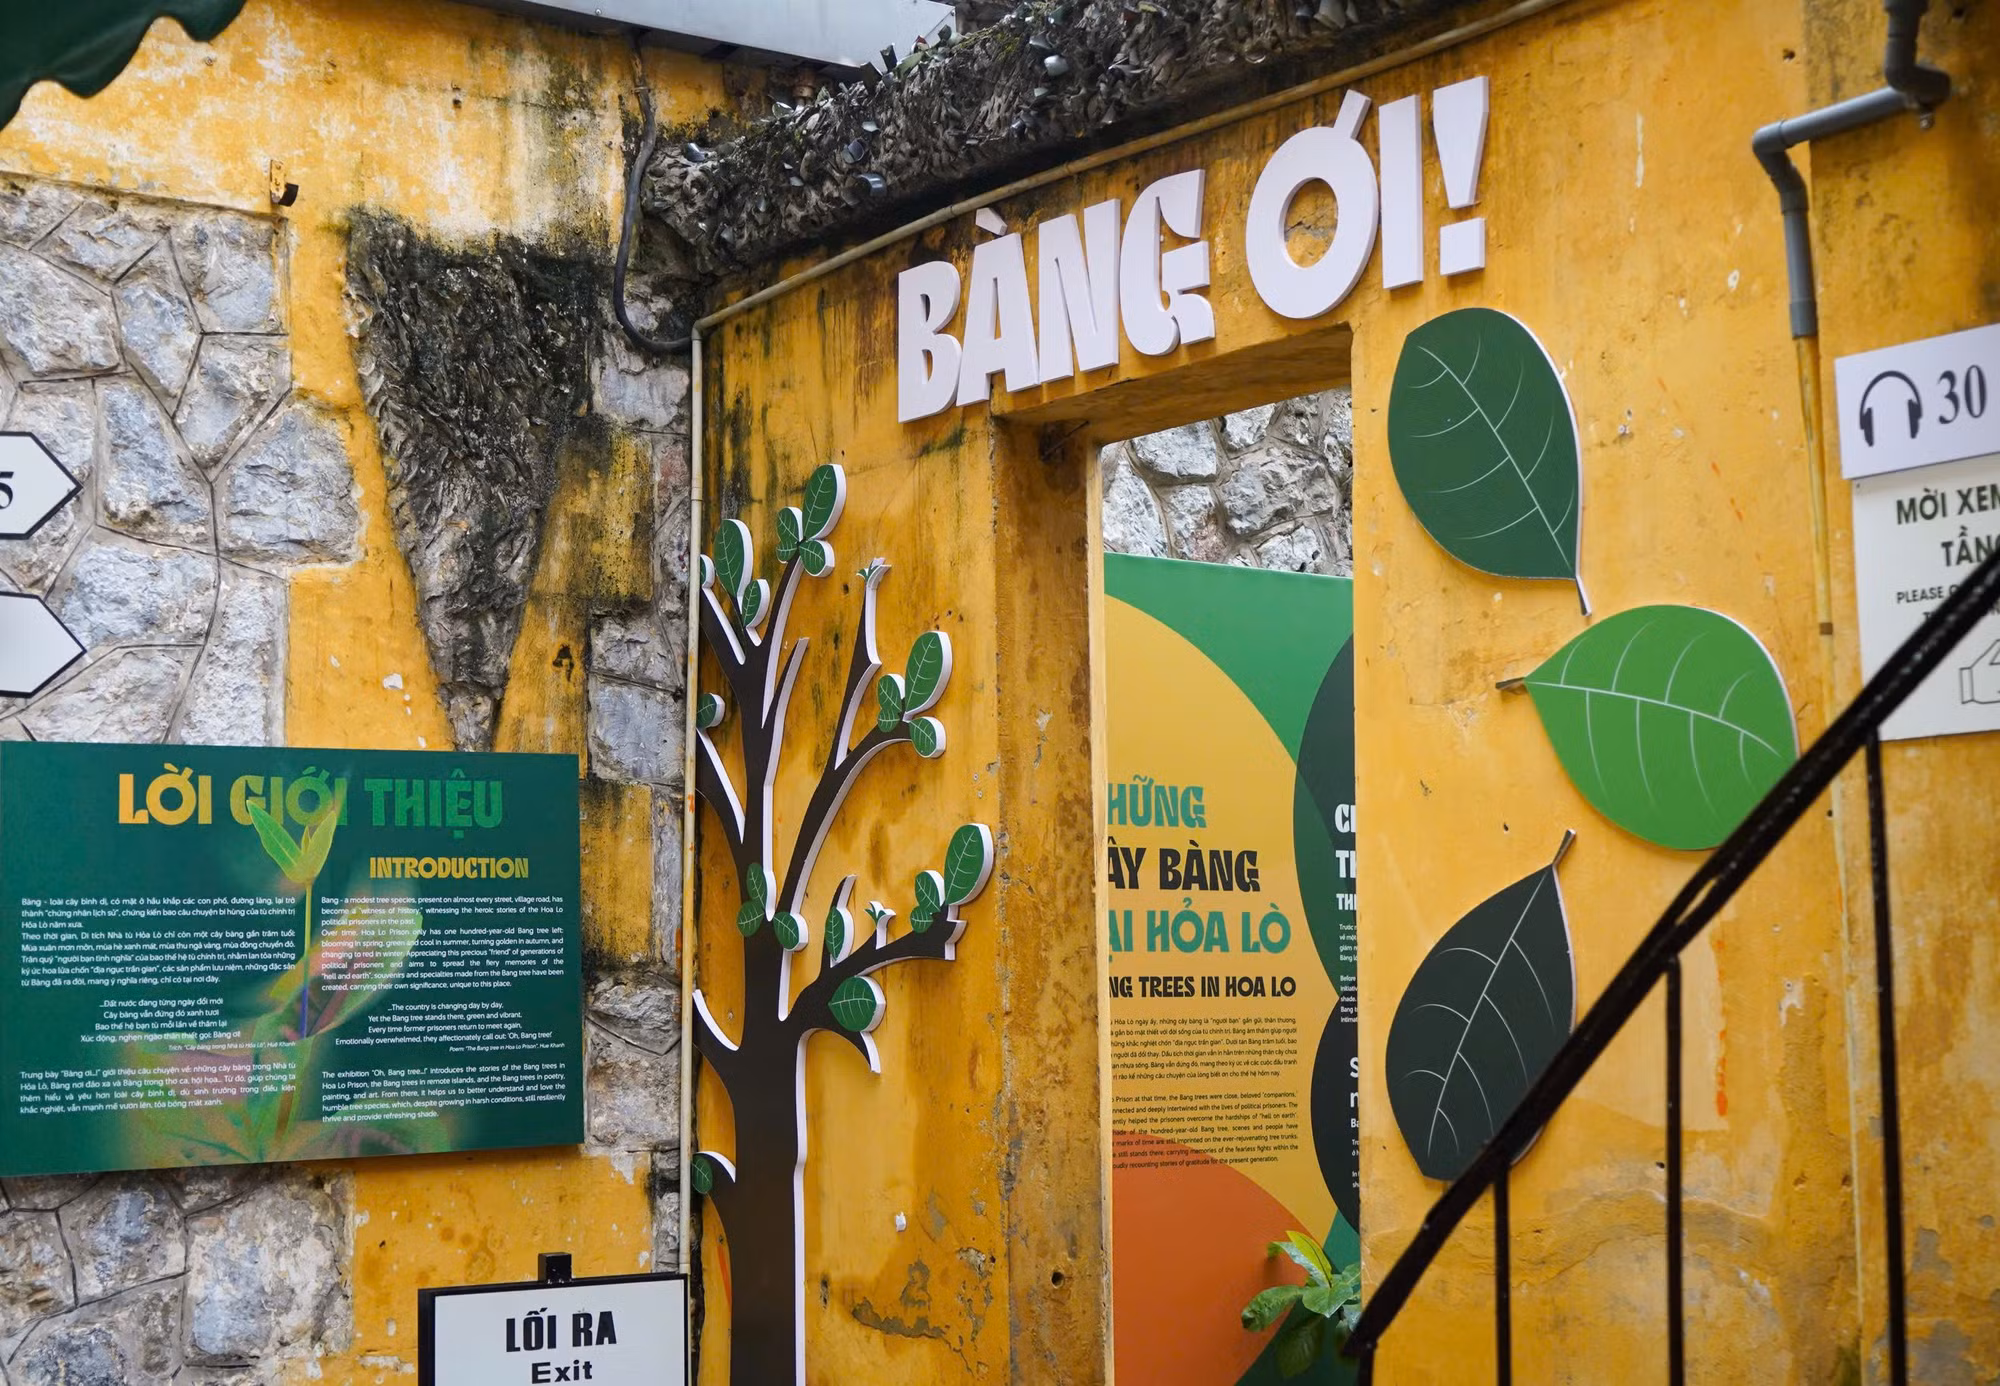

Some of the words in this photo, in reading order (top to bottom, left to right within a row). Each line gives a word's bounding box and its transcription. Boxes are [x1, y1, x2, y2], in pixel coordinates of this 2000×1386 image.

[898, 168, 1216, 423] BÀNG
[1246, 75, 1489, 319] ƠI!
[1937, 364, 1987, 425] 30
[0, 471, 14, 510] 5
[1896, 488, 1948, 525] MỜI
[1941, 525, 2000, 567] TẦN
[1896, 586, 1943, 604] PLEASE
[118, 762, 213, 826] LỜI
[230, 766, 348, 827] GIỚI
[364, 768, 503, 840] THIỆU
[369, 856, 530, 879] INTRODUCTION
[1159, 839, 1261, 892] BÀNG
[1146, 896, 1230, 954] HỎA
[1241, 902, 1291, 954] LÒ
[1138, 976, 1196, 998] TREES
[1201, 976, 1219, 997] IN
[1225, 976, 1266, 997] HOA
[1271, 976, 1297, 997] LO
[505, 1307, 557, 1353] LỐI
[572, 1310, 617, 1347] RA
[531, 1359, 593, 1385] Exit
